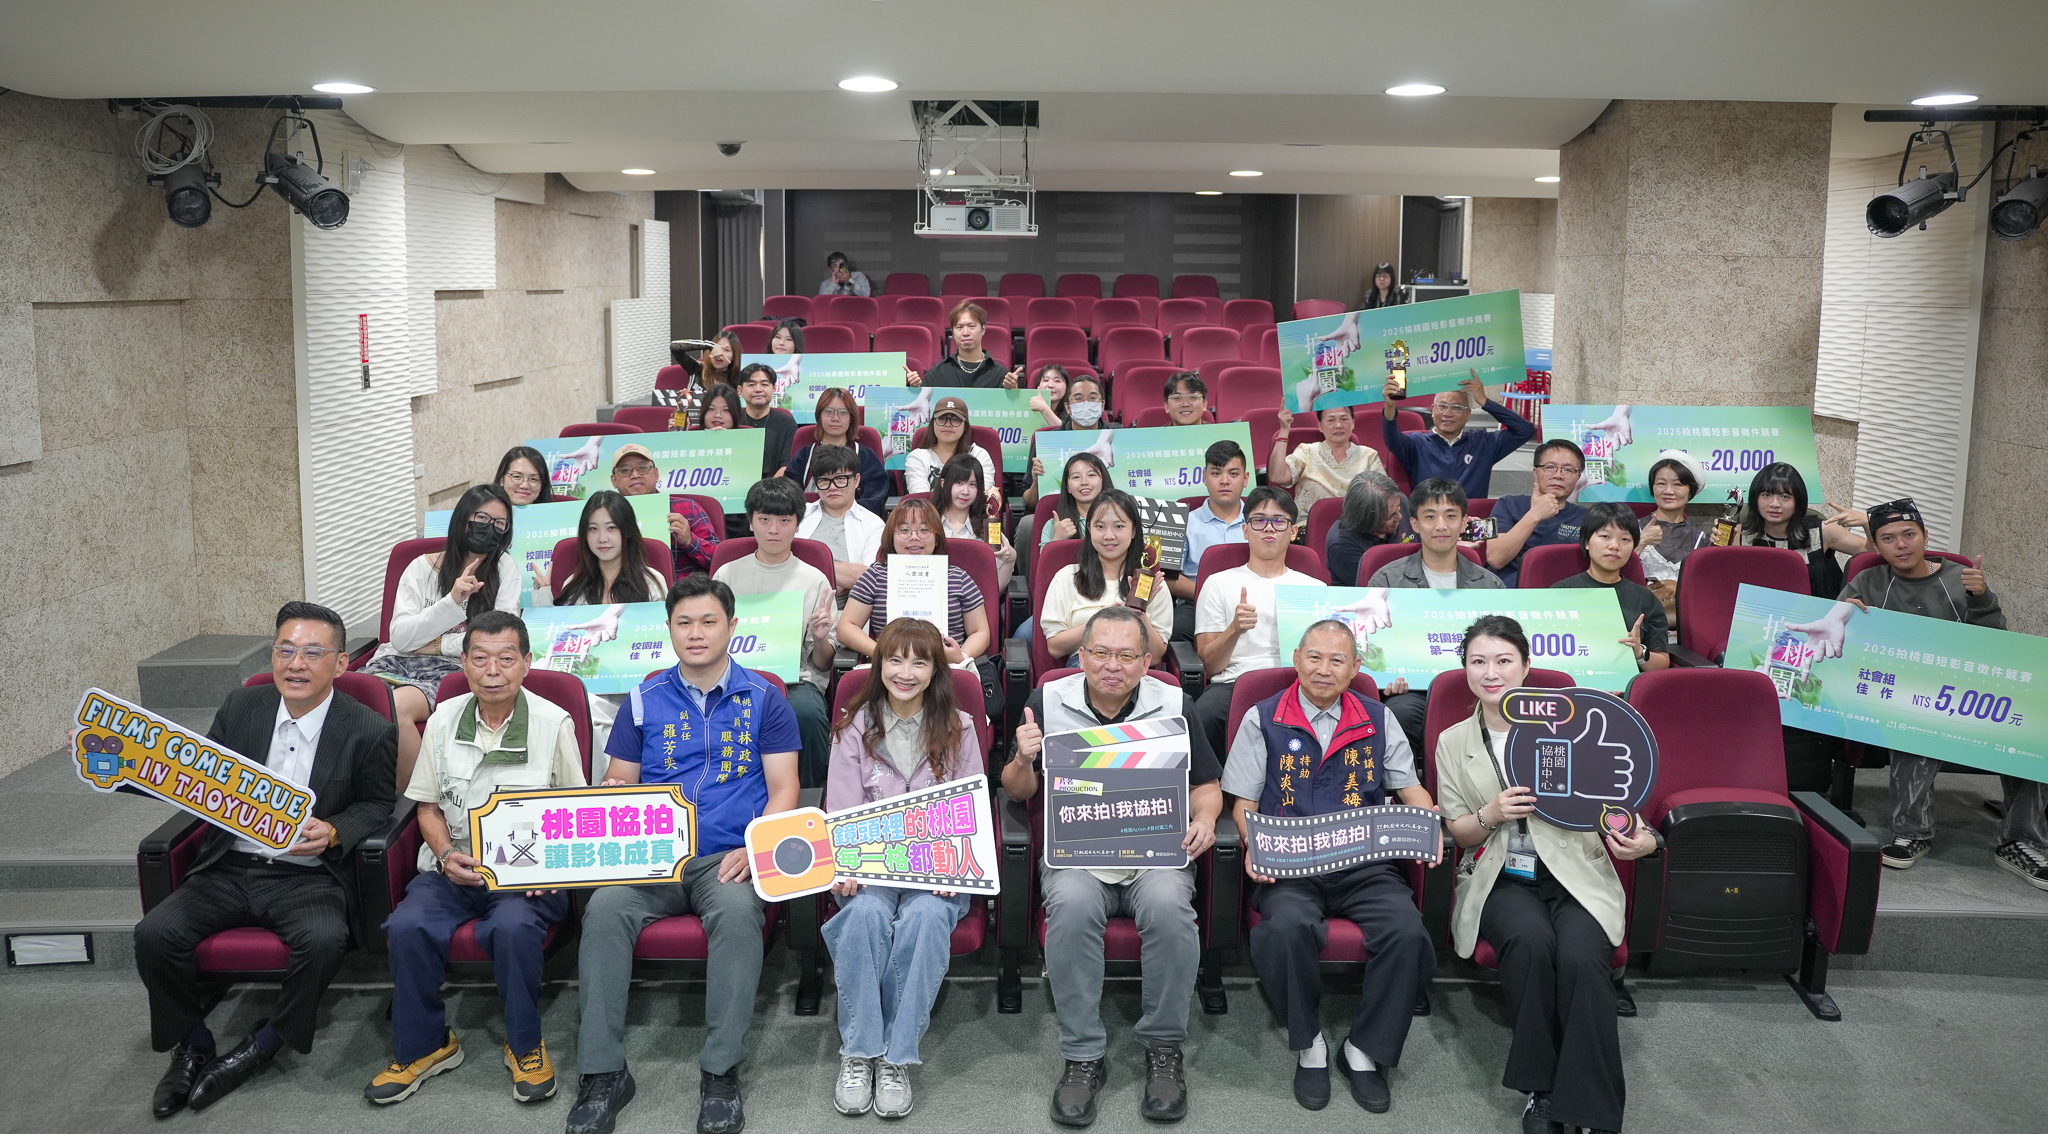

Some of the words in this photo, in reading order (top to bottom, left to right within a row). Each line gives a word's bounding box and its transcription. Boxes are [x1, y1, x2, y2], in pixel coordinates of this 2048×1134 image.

[1382, 314, 1492, 337] 2026拍桃園短影音徵件競賽
[1657, 428, 1780, 437] 2026拍桃園短影音徵件競賽
[666, 467, 724, 490] 10,000
[1128, 468, 1152, 478] 社會組
[632, 641, 663, 650] 校園組
[1427, 632, 1464, 644] 校園組
[1858, 668, 1896, 686] 社會組
[1864, 642, 2033, 684] 2026拍桃園短影音徵件競賽
[1520, 700, 1558, 716] LIKE
[680, 710, 692, 742] 副主任
[83, 697, 162, 750] FILMS
[164, 736, 235, 786] COME
[236, 771, 306, 820] TRUE
[662, 724, 678, 770] 羅芳奕
[1363, 746, 1375, 782] 市議員
[1280, 753, 1296, 806] 陳炎山
[1342, 748, 1362, 807] 陳美梅
[138, 756, 171, 786] IN
[173, 772, 293, 845] TAOYUAN
[540, 804, 674, 840] 桃園協拍
[833, 793, 976, 846] 鏡頭裡的桃園
[544, 838, 675, 870] 讓影像成真
[836, 838, 984, 878] 每一格都動人
